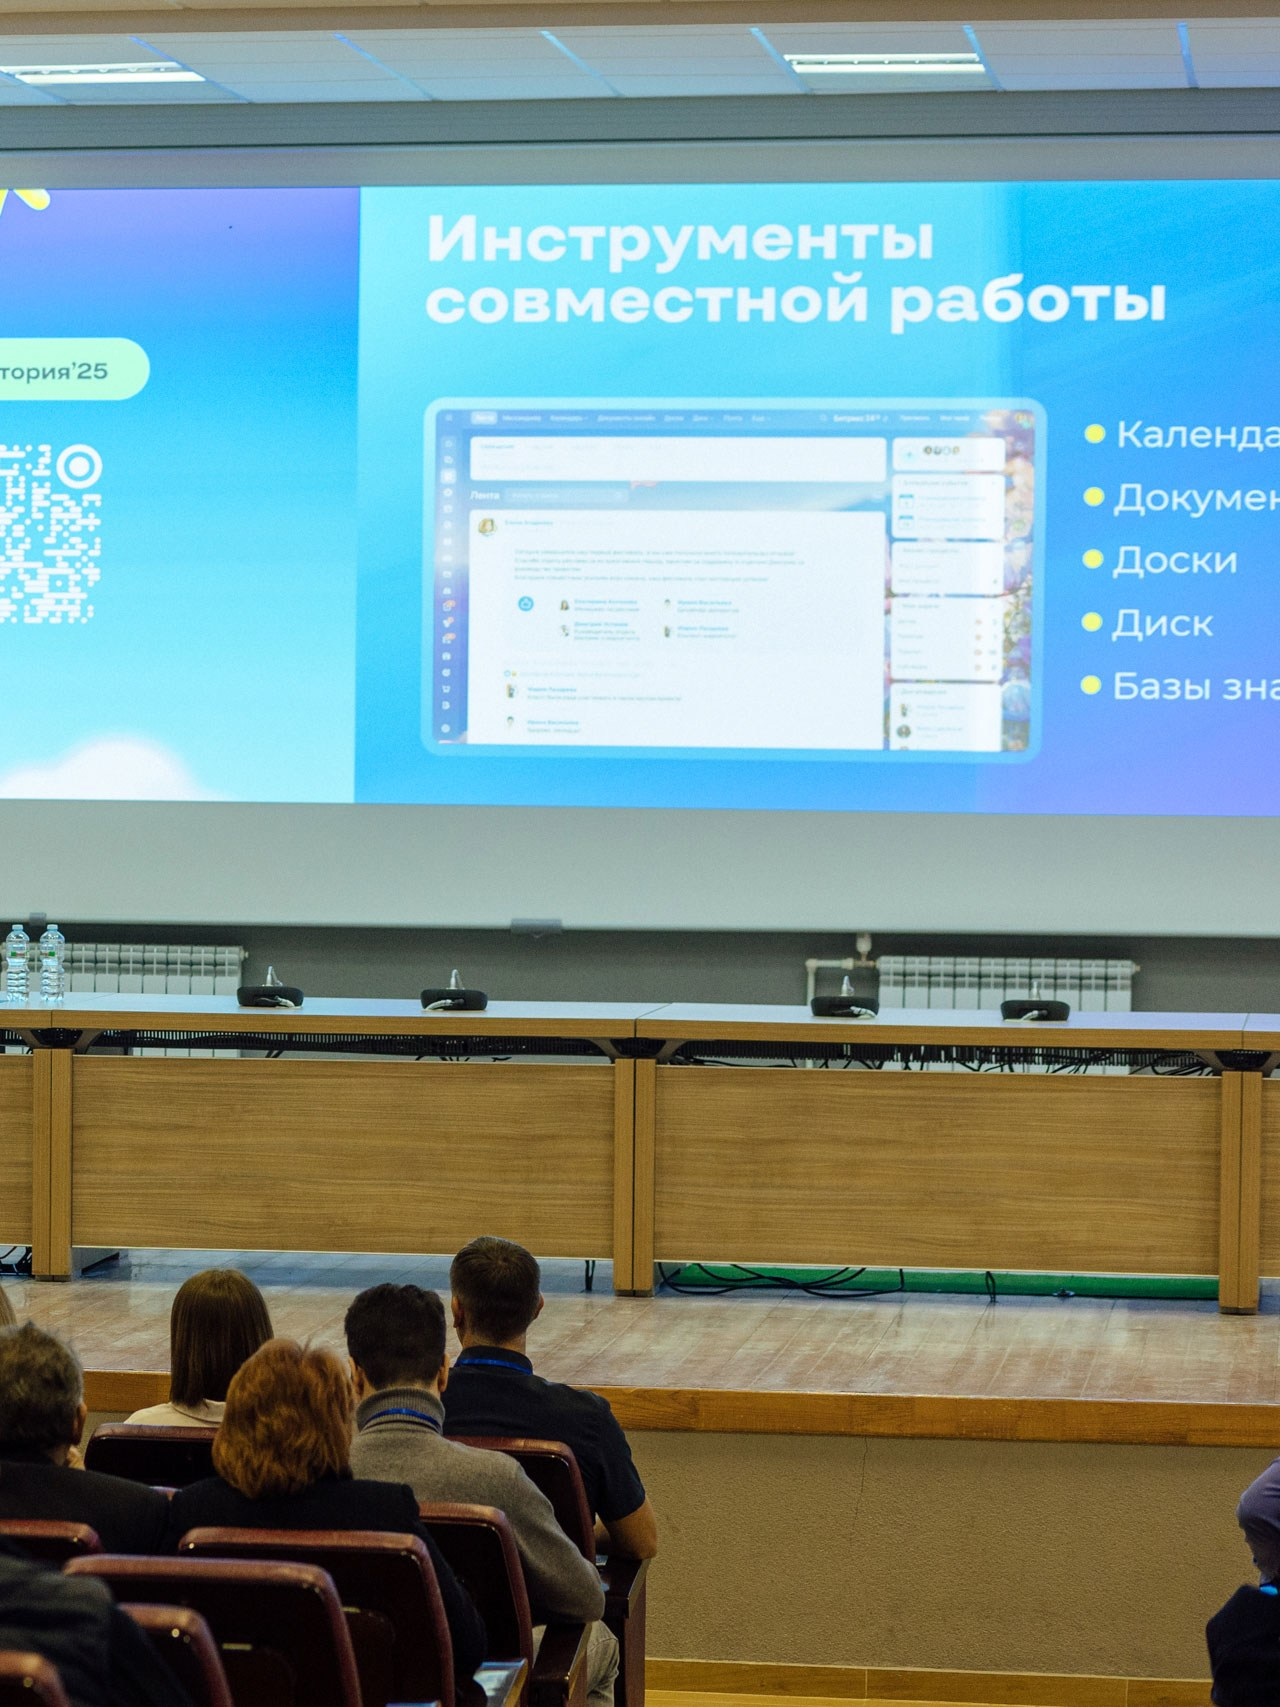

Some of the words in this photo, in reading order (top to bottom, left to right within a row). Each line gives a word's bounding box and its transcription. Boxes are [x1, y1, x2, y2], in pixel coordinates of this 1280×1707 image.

[428, 213, 934, 275] Инструменты
[425, 271, 868, 325] совместной
[890, 272, 1166, 335] работы
[1118, 420, 1280, 452] Календа
[1112, 546, 1238, 579] Доски
[1111, 609, 1215, 642] Диск
[1114, 672, 1211, 700] Базы
